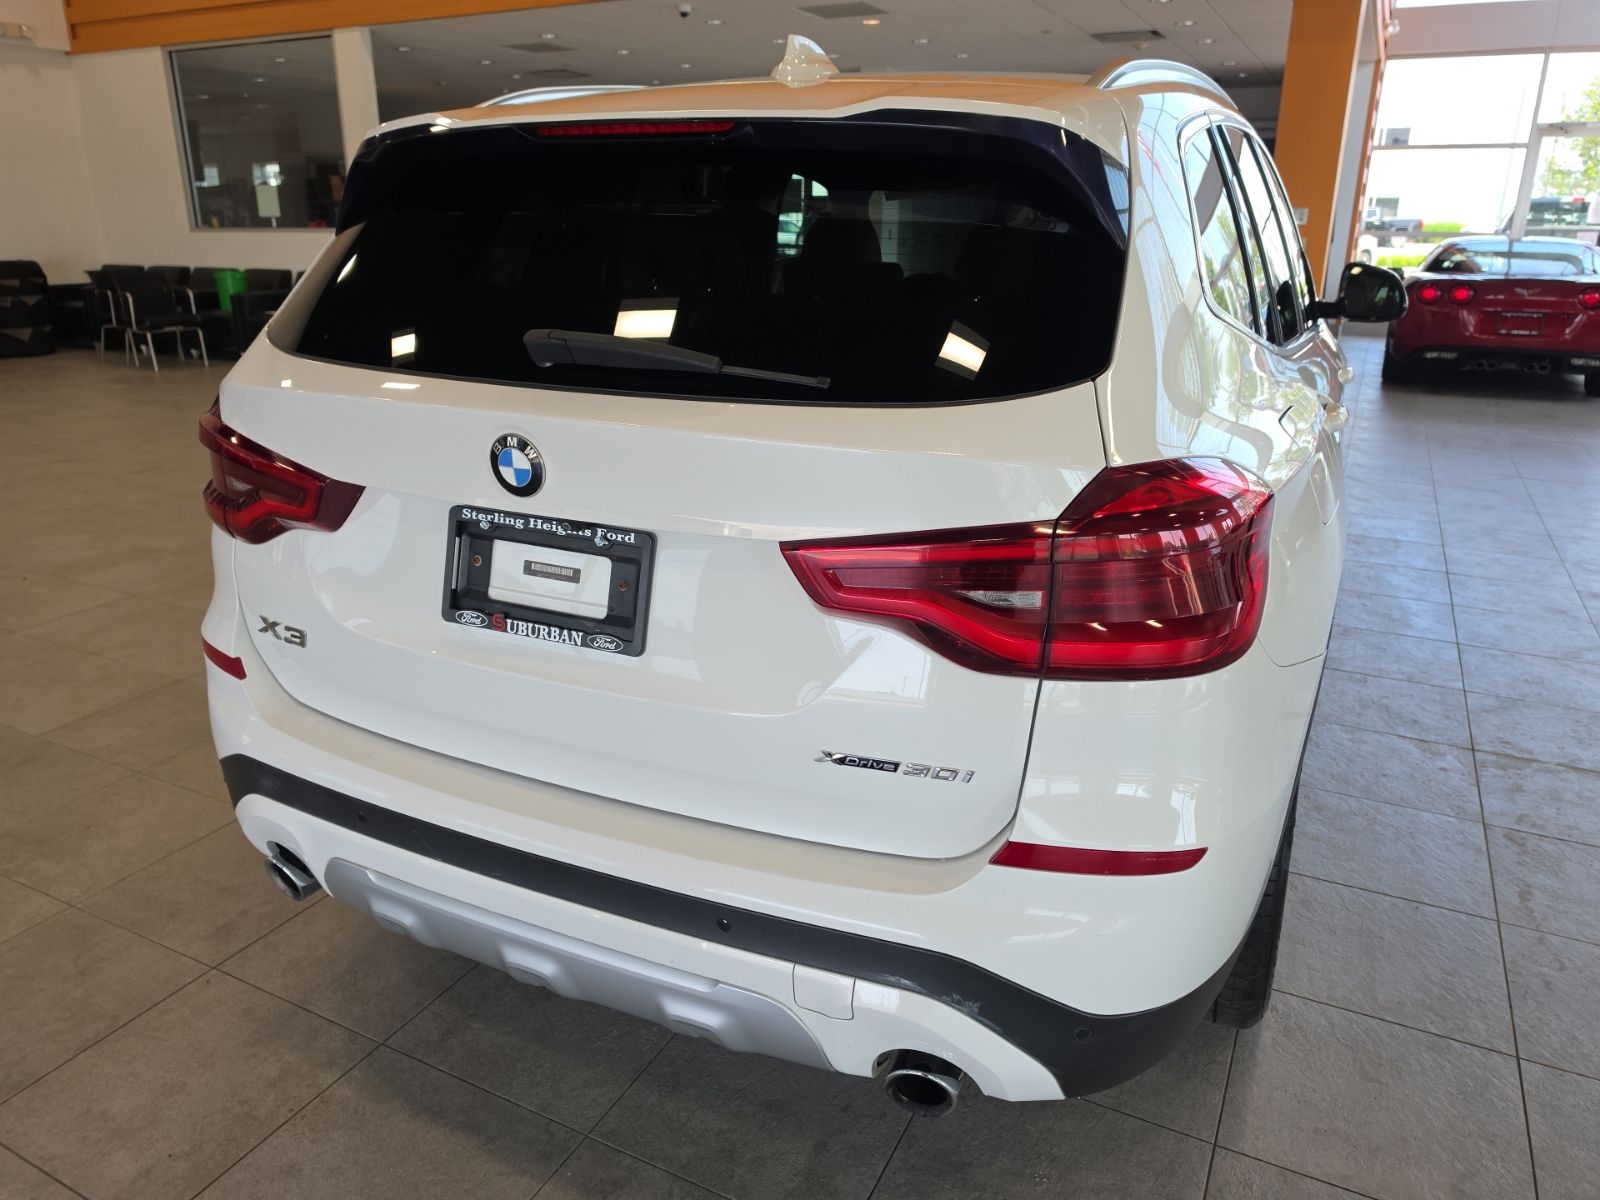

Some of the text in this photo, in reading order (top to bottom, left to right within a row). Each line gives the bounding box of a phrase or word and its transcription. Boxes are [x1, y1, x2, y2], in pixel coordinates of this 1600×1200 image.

[462, 508, 635, 543] Sterling Heigs Ford
[257, 615, 307, 648] X3
[492, 612, 583, 646] SUBURBAN
